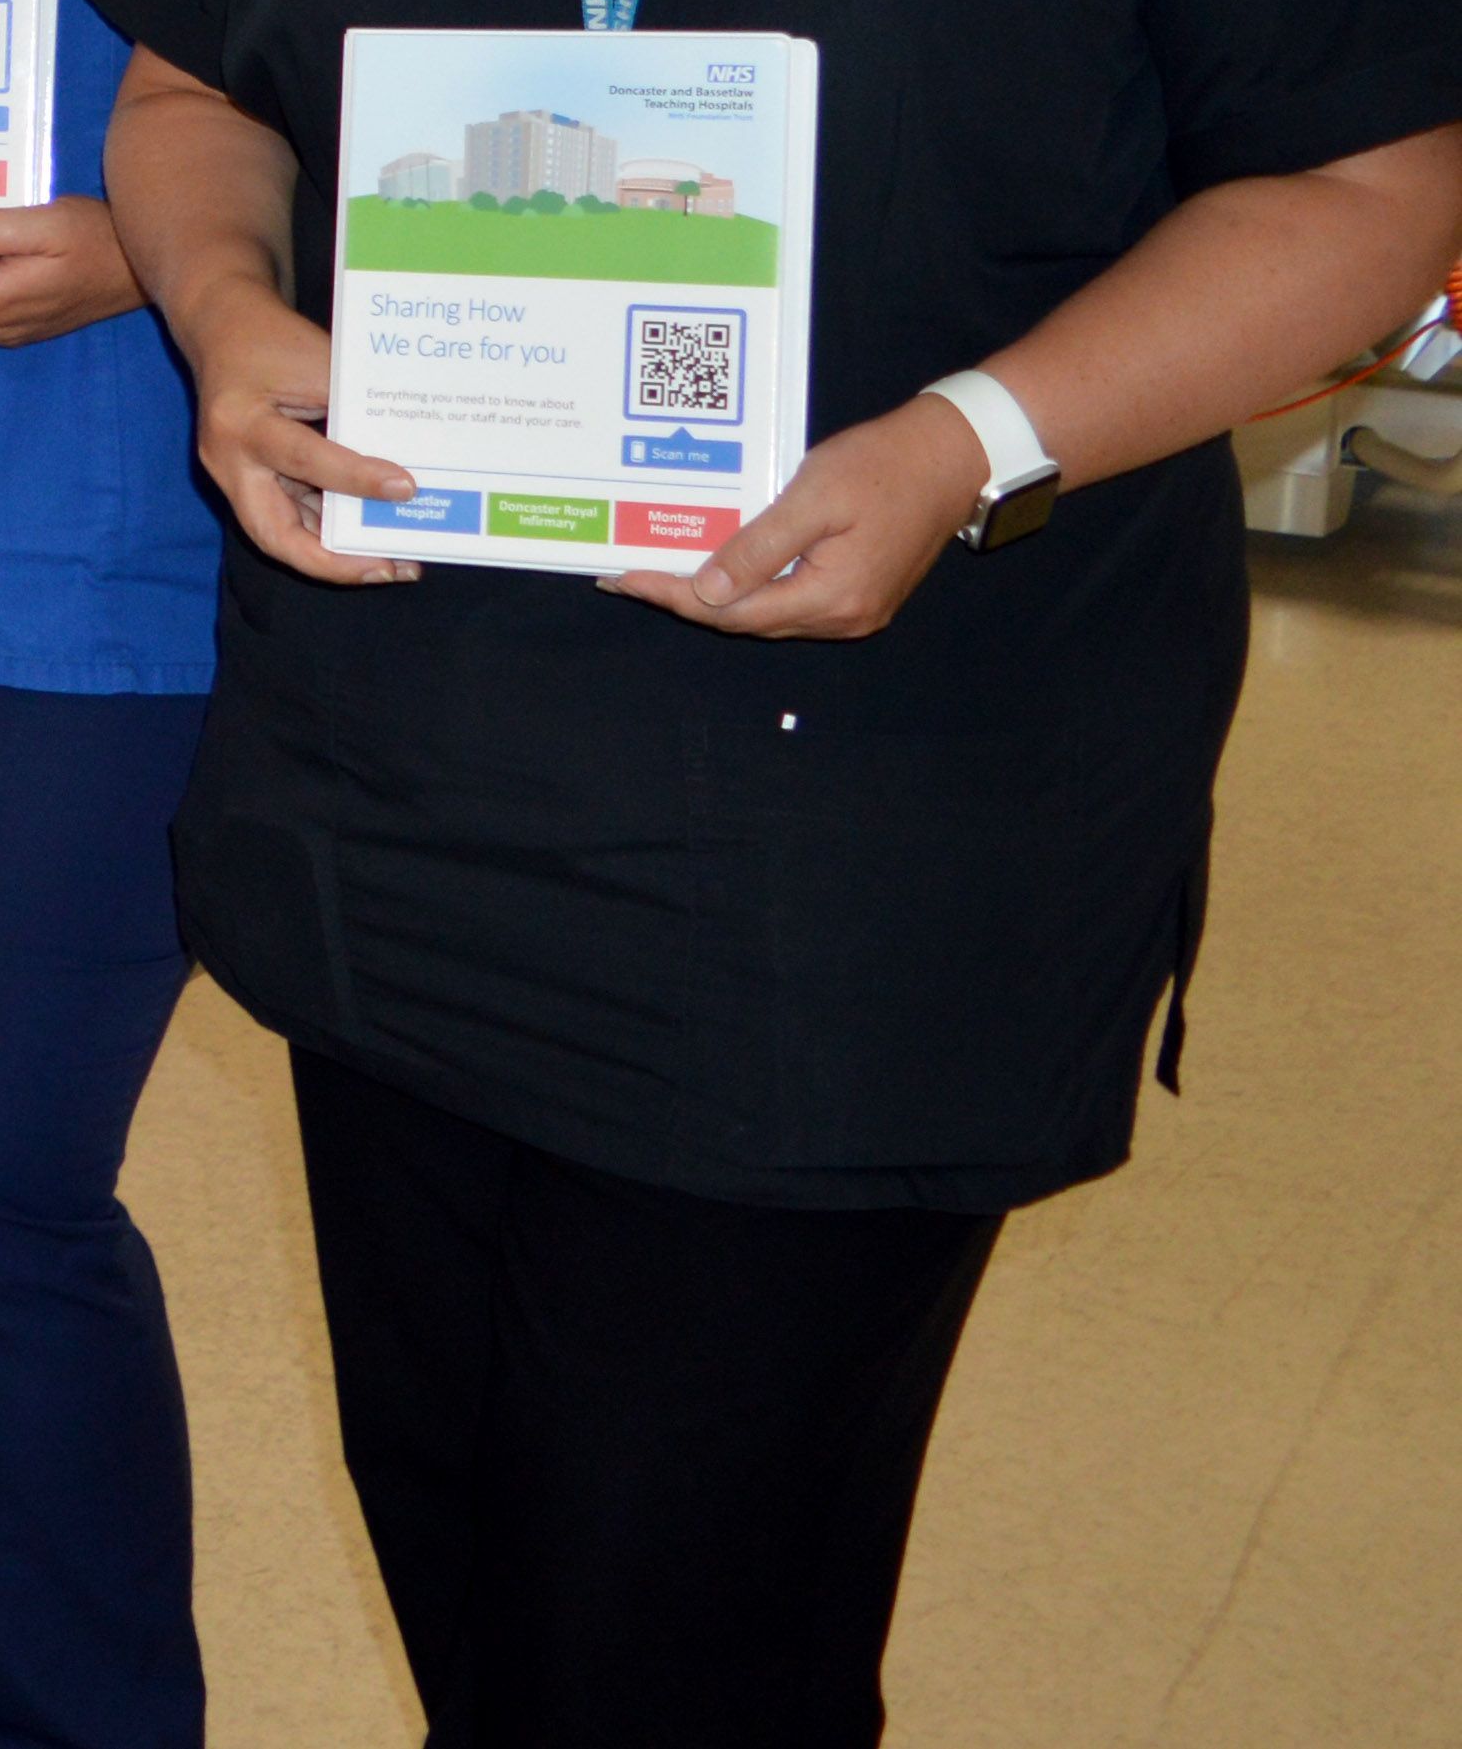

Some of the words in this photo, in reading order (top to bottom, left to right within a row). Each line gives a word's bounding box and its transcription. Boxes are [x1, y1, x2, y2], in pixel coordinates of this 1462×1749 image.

[708, 65, 753, 83] NHS
[370, 293, 462, 326] Sharing
[468, 297, 526, 323] How
[370, 331, 410, 356] We
[417, 334, 473, 359] Care
[479, 335, 515, 361] for
[520, 345, 565, 367] you
[651, 447, 683, 460] Scan
[688, 451, 709, 462] me
[395, 506, 444, 520] Hospital
[498, 499, 560, 515] Doncaster
[562, 504, 597, 519] Royal
[518, 514, 576, 531] Infirmary
[647, 510, 705, 527] Montagu
[650, 523, 702, 538] Hospital
